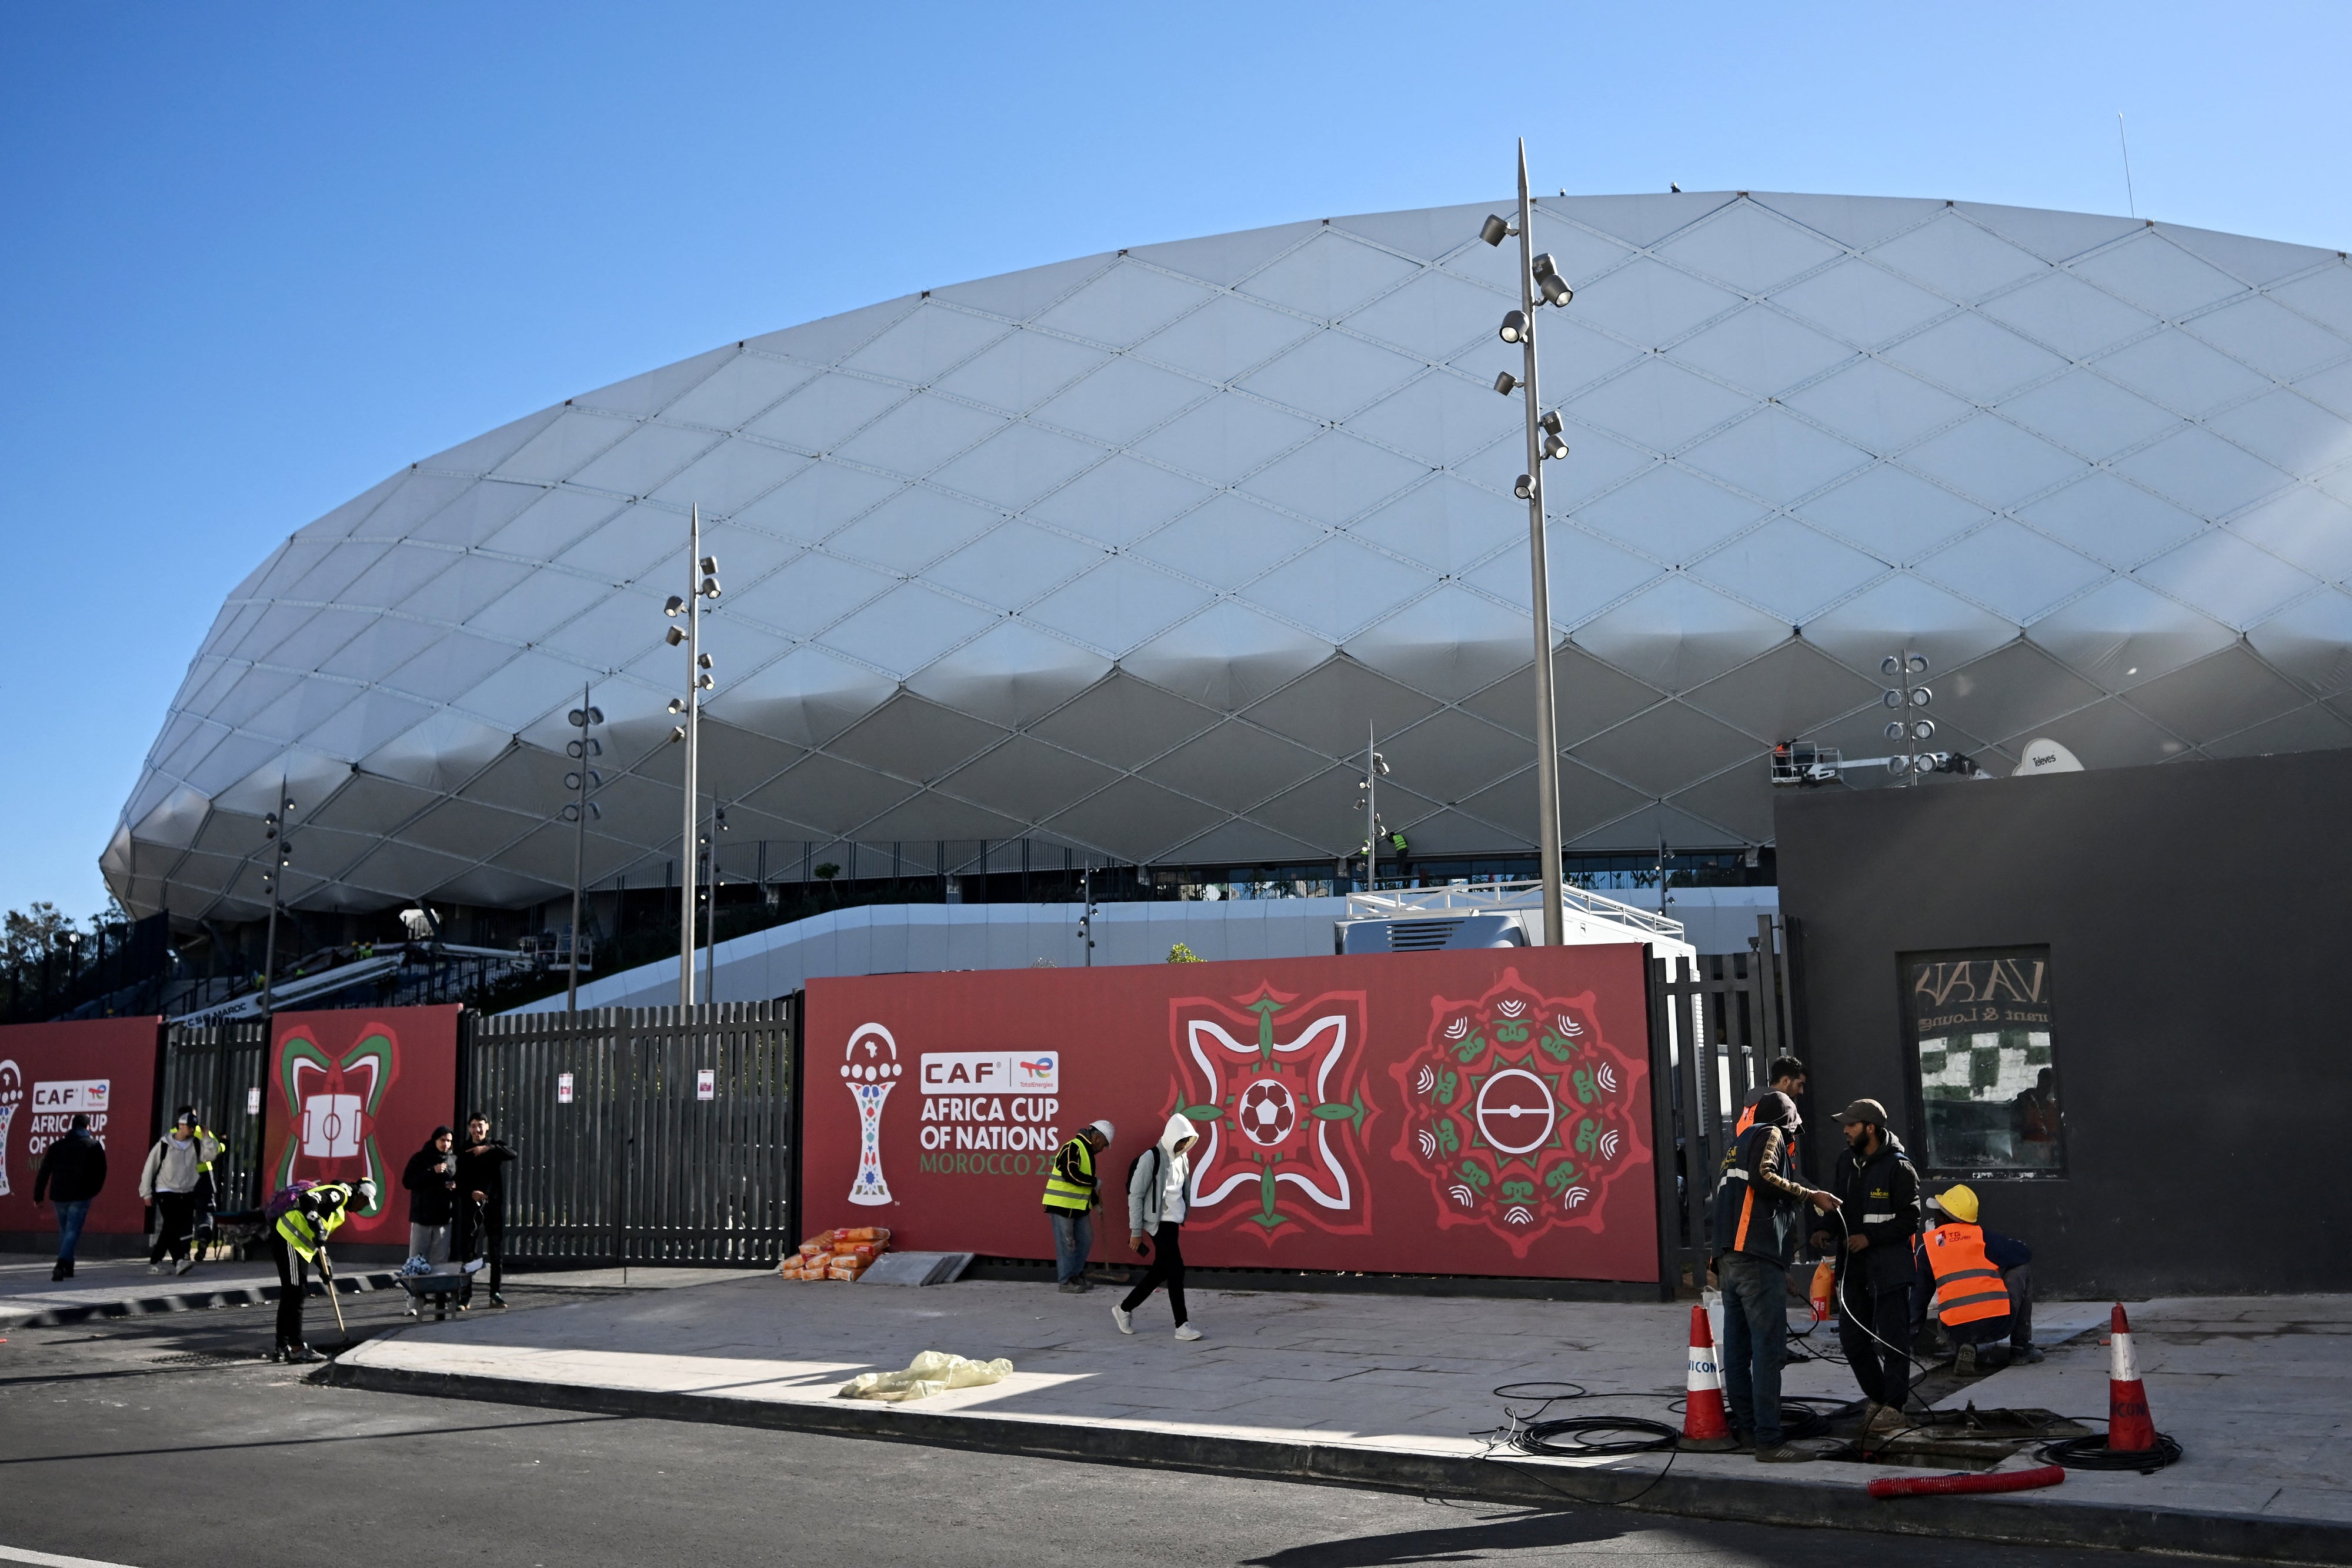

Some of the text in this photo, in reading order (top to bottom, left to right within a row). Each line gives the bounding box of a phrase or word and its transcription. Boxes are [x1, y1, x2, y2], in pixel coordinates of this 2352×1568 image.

[2033, 755, 2056, 767] Televes
[925, 1063, 993, 1083] CAF
[35, 1089, 74, 1105] CAF
[920, 1097, 1059, 1122] AFRICA CUP
[86, 1113, 108, 1132] UP
[29, 1136, 47, 1154] OF
[920, 1126, 1059, 1151] OF NATIONS
[920, 1153, 1030, 1175] MOROCCO
